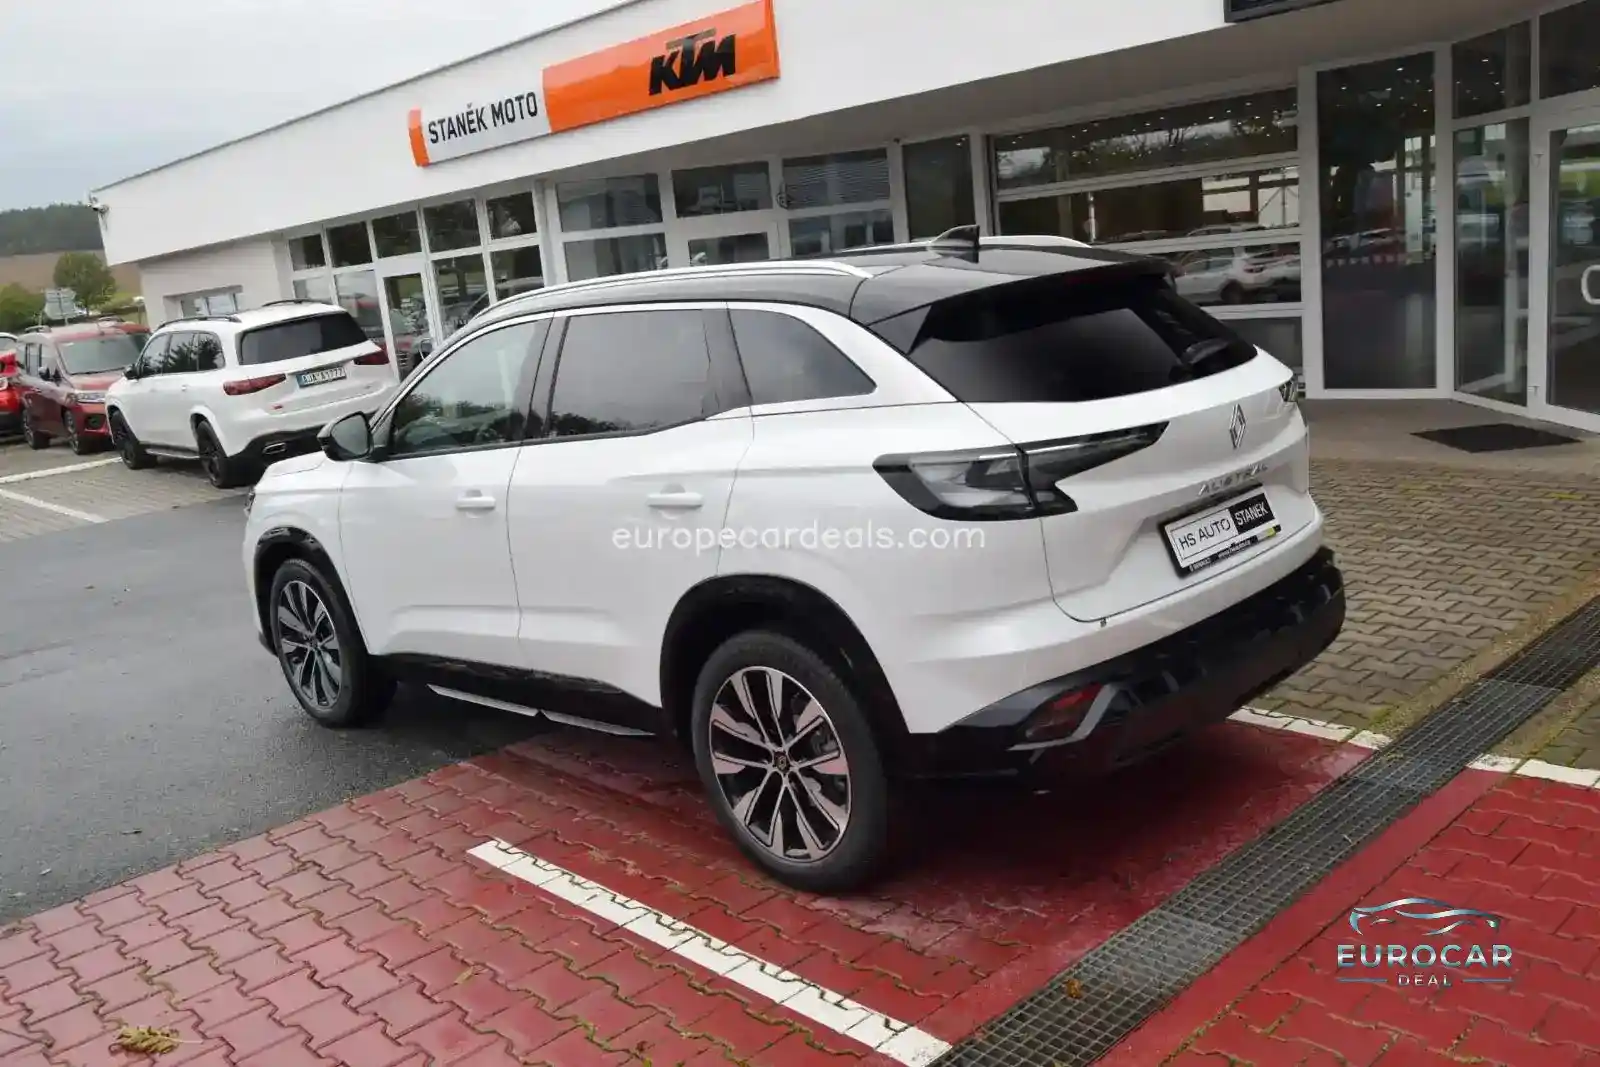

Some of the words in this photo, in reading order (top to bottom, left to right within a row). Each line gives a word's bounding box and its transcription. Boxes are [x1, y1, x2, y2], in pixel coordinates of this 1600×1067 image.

[648, 28, 736, 96] KTM
[428, 103, 487, 145] STANĚK
[490, 91, 538, 128] MOTO
[1179, 533, 1197, 550] HS
[1199, 518, 1231, 542] AUTO
